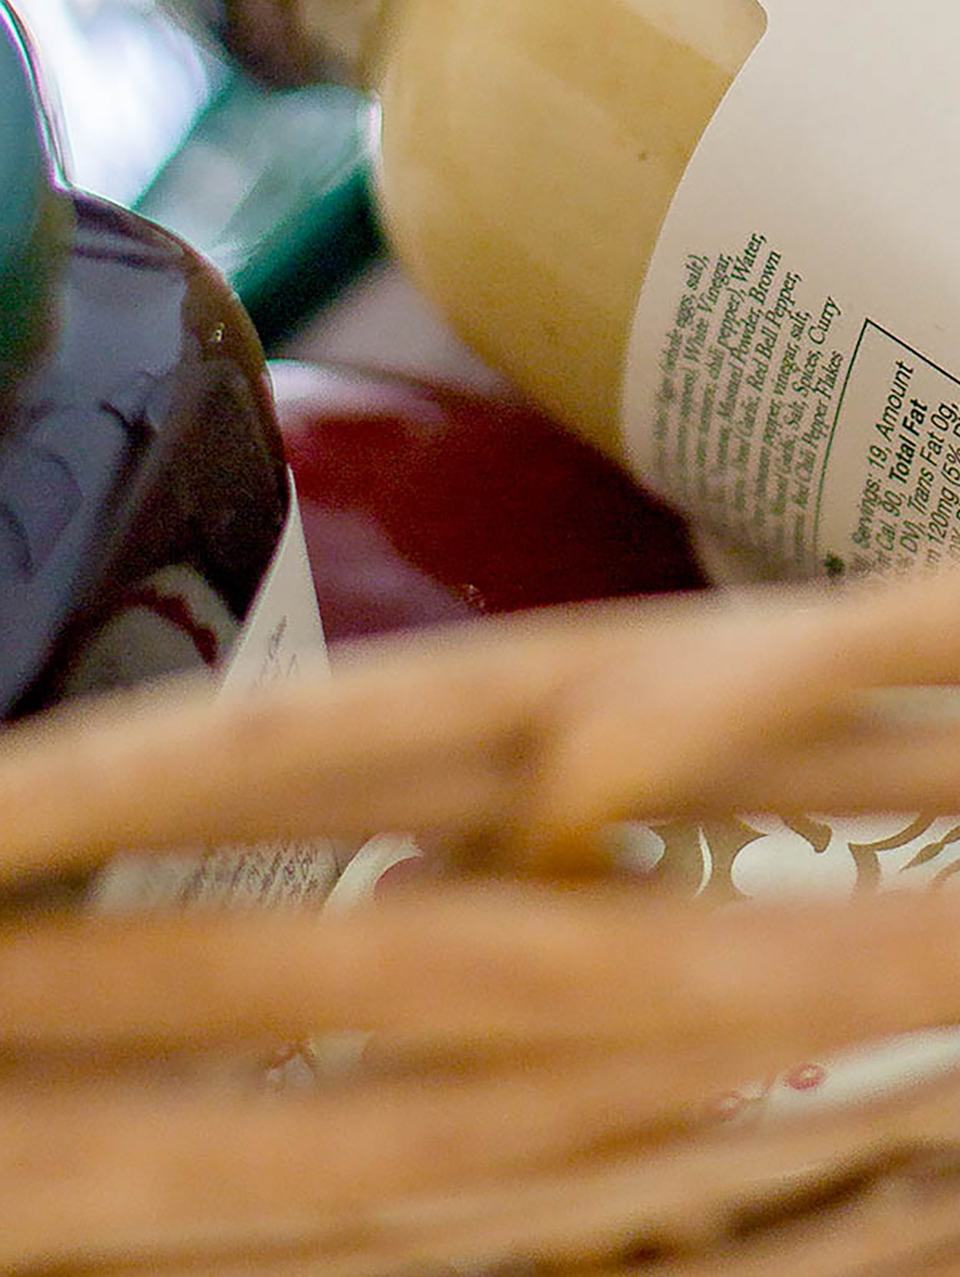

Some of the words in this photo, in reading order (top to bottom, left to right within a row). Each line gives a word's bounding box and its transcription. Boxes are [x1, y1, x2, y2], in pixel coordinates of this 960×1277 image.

[685, 254, 710, 291] salt),
[730, 233, 768, 283] Water,
[696, 253, 734, 314] Vinegar,
[729, 307, 764, 365] Powder,
[748, 250, 782, 305] Brown
[765, 271, 802, 329] Pepper,
[717, 287, 746, 351] pepper),
[754, 325, 779, 360] Bell
[789, 310, 812, 341] salt,
[791, 349, 822, 397] Spices,
[807, 295, 841, 345] Curry
[746, 357, 769, 393] Red
[812, 349, 844, 401] Flakes
[802, 398, 829, 448] Pepper
[875, 360, 915, 442] Amount
[902, 398, 928, 437] Fat
[931, 402, 960, 432] 0g,
[866, 444, 891, 470] 19,
[889, 434, 917, 485] Total
[919, 431, 944, 467] Fat
[852, 473, 881, 549] Servings:
[882, 490, 905, 518] 90,
[907, 467, 935, 515] Trans
[927, 486, 960, 547] 120mg
